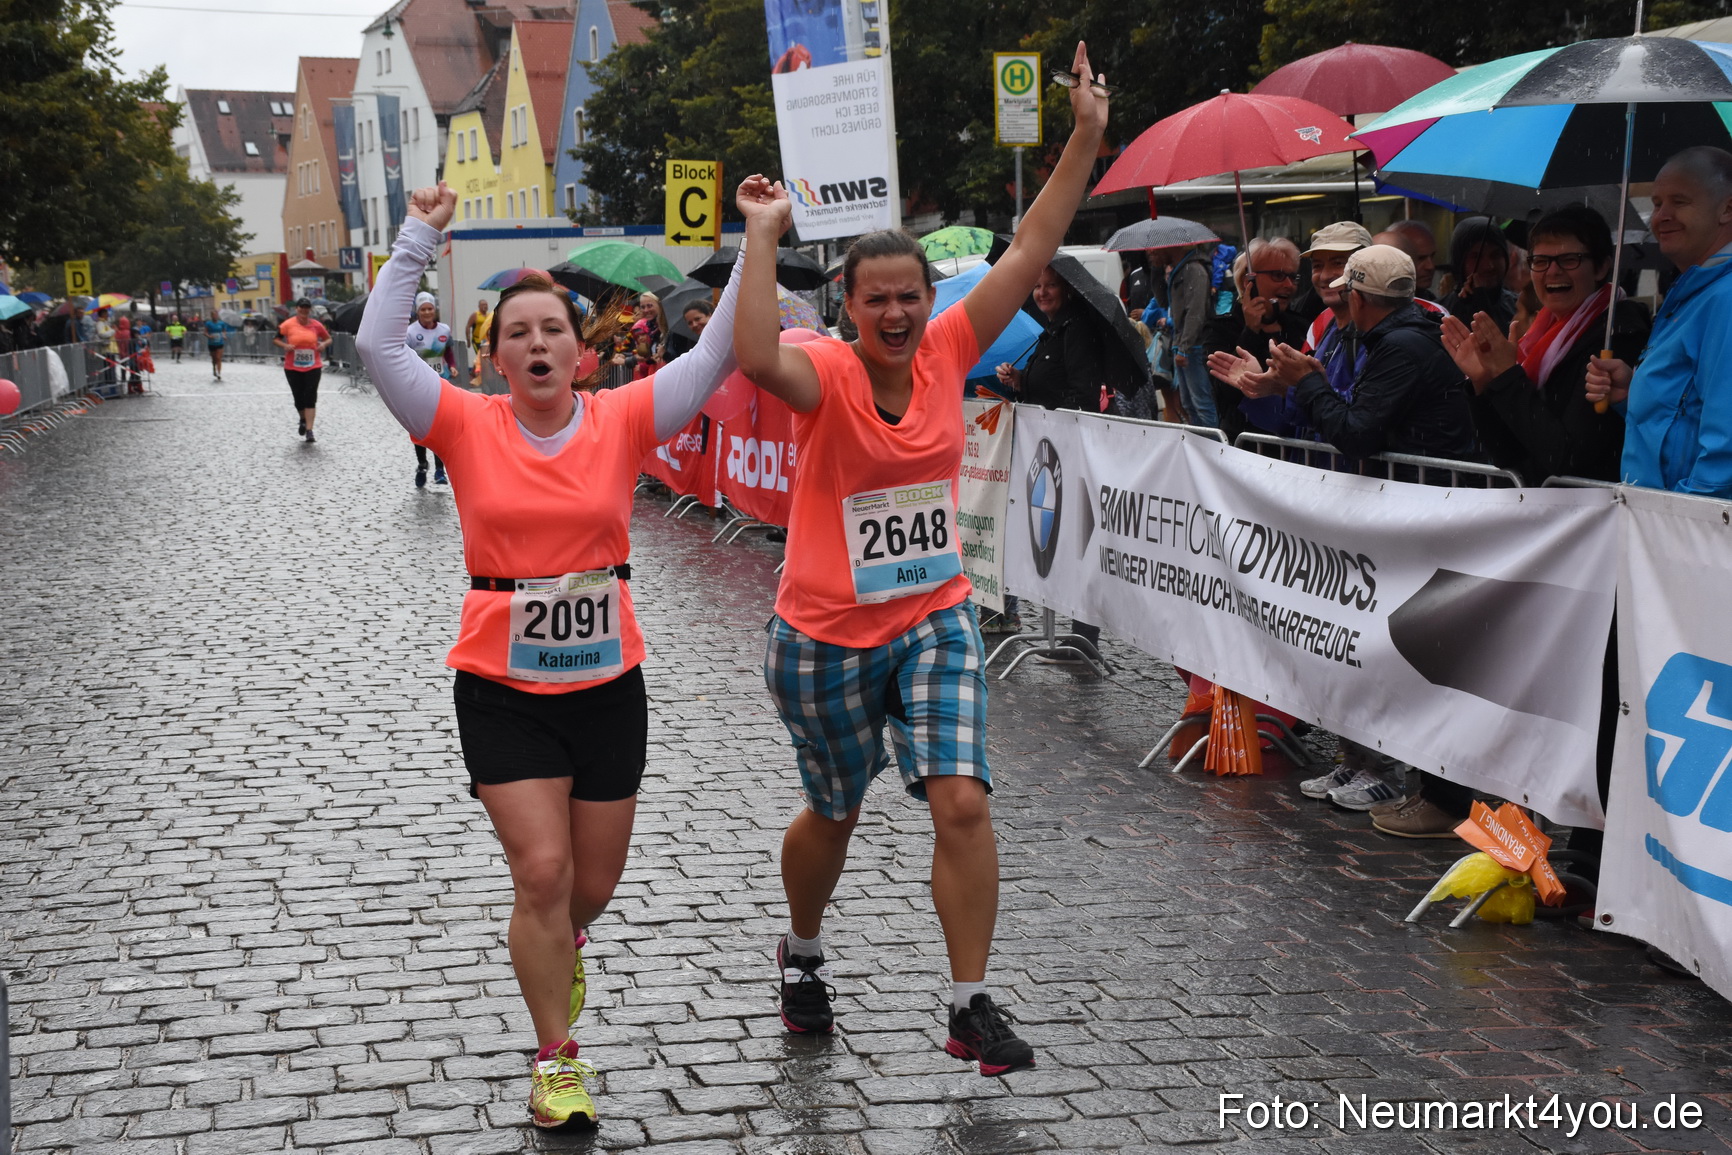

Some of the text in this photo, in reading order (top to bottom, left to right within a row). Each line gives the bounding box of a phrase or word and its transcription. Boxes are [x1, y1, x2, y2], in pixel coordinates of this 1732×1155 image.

[673, 164, 716, 180] Block
[679, 186, 708, 229] C
[72, 271, 86, 288] D
[1030, 442, 1062, 490] BMW
[852, 502, 890, 513] NeuerMarkt
[895, 485, 944, 504] BOCK
[1100, 485, 1145, 539] BMW
[859, 508, 948, 560] 2648
[897, 565, 927, 584] Anja
[524, 593, 609, 641] 2091
[1100, 544, 1147, 588] WENIGER
[1149, 560, 1234, 616] VERBRAUCH.
[1260, 601, 1362, 669] FAHRFREUDE.
[538, 650, 600, 668] Katarina
[1485, 814, 1527, 860] BRANDING
